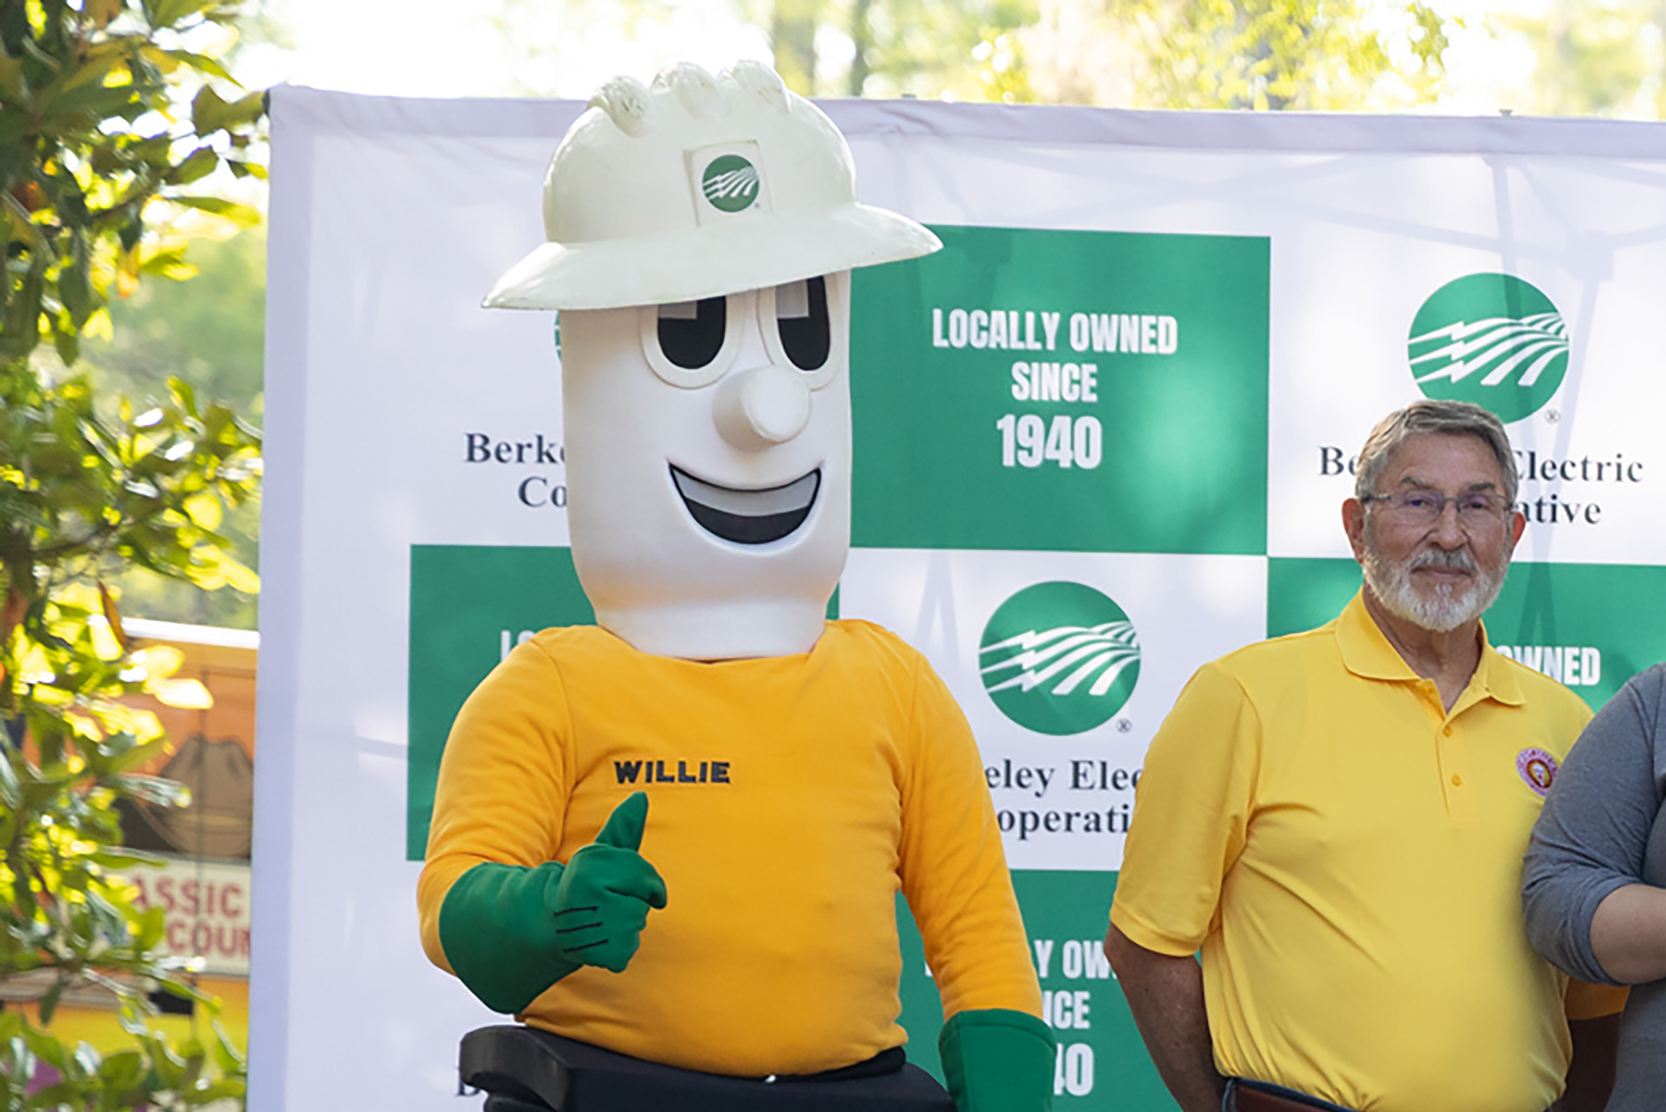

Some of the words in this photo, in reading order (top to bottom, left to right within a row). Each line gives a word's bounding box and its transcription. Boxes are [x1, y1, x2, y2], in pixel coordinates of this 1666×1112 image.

[932, 308, 1060, 350] LOCALLY
[1069, 312, 1178, 355] OWNED
[1010, 361, 1098, 402] SINCE
[996, 413, 1102, 469] 1940
[613, 760, 730, 784] WILLIE
